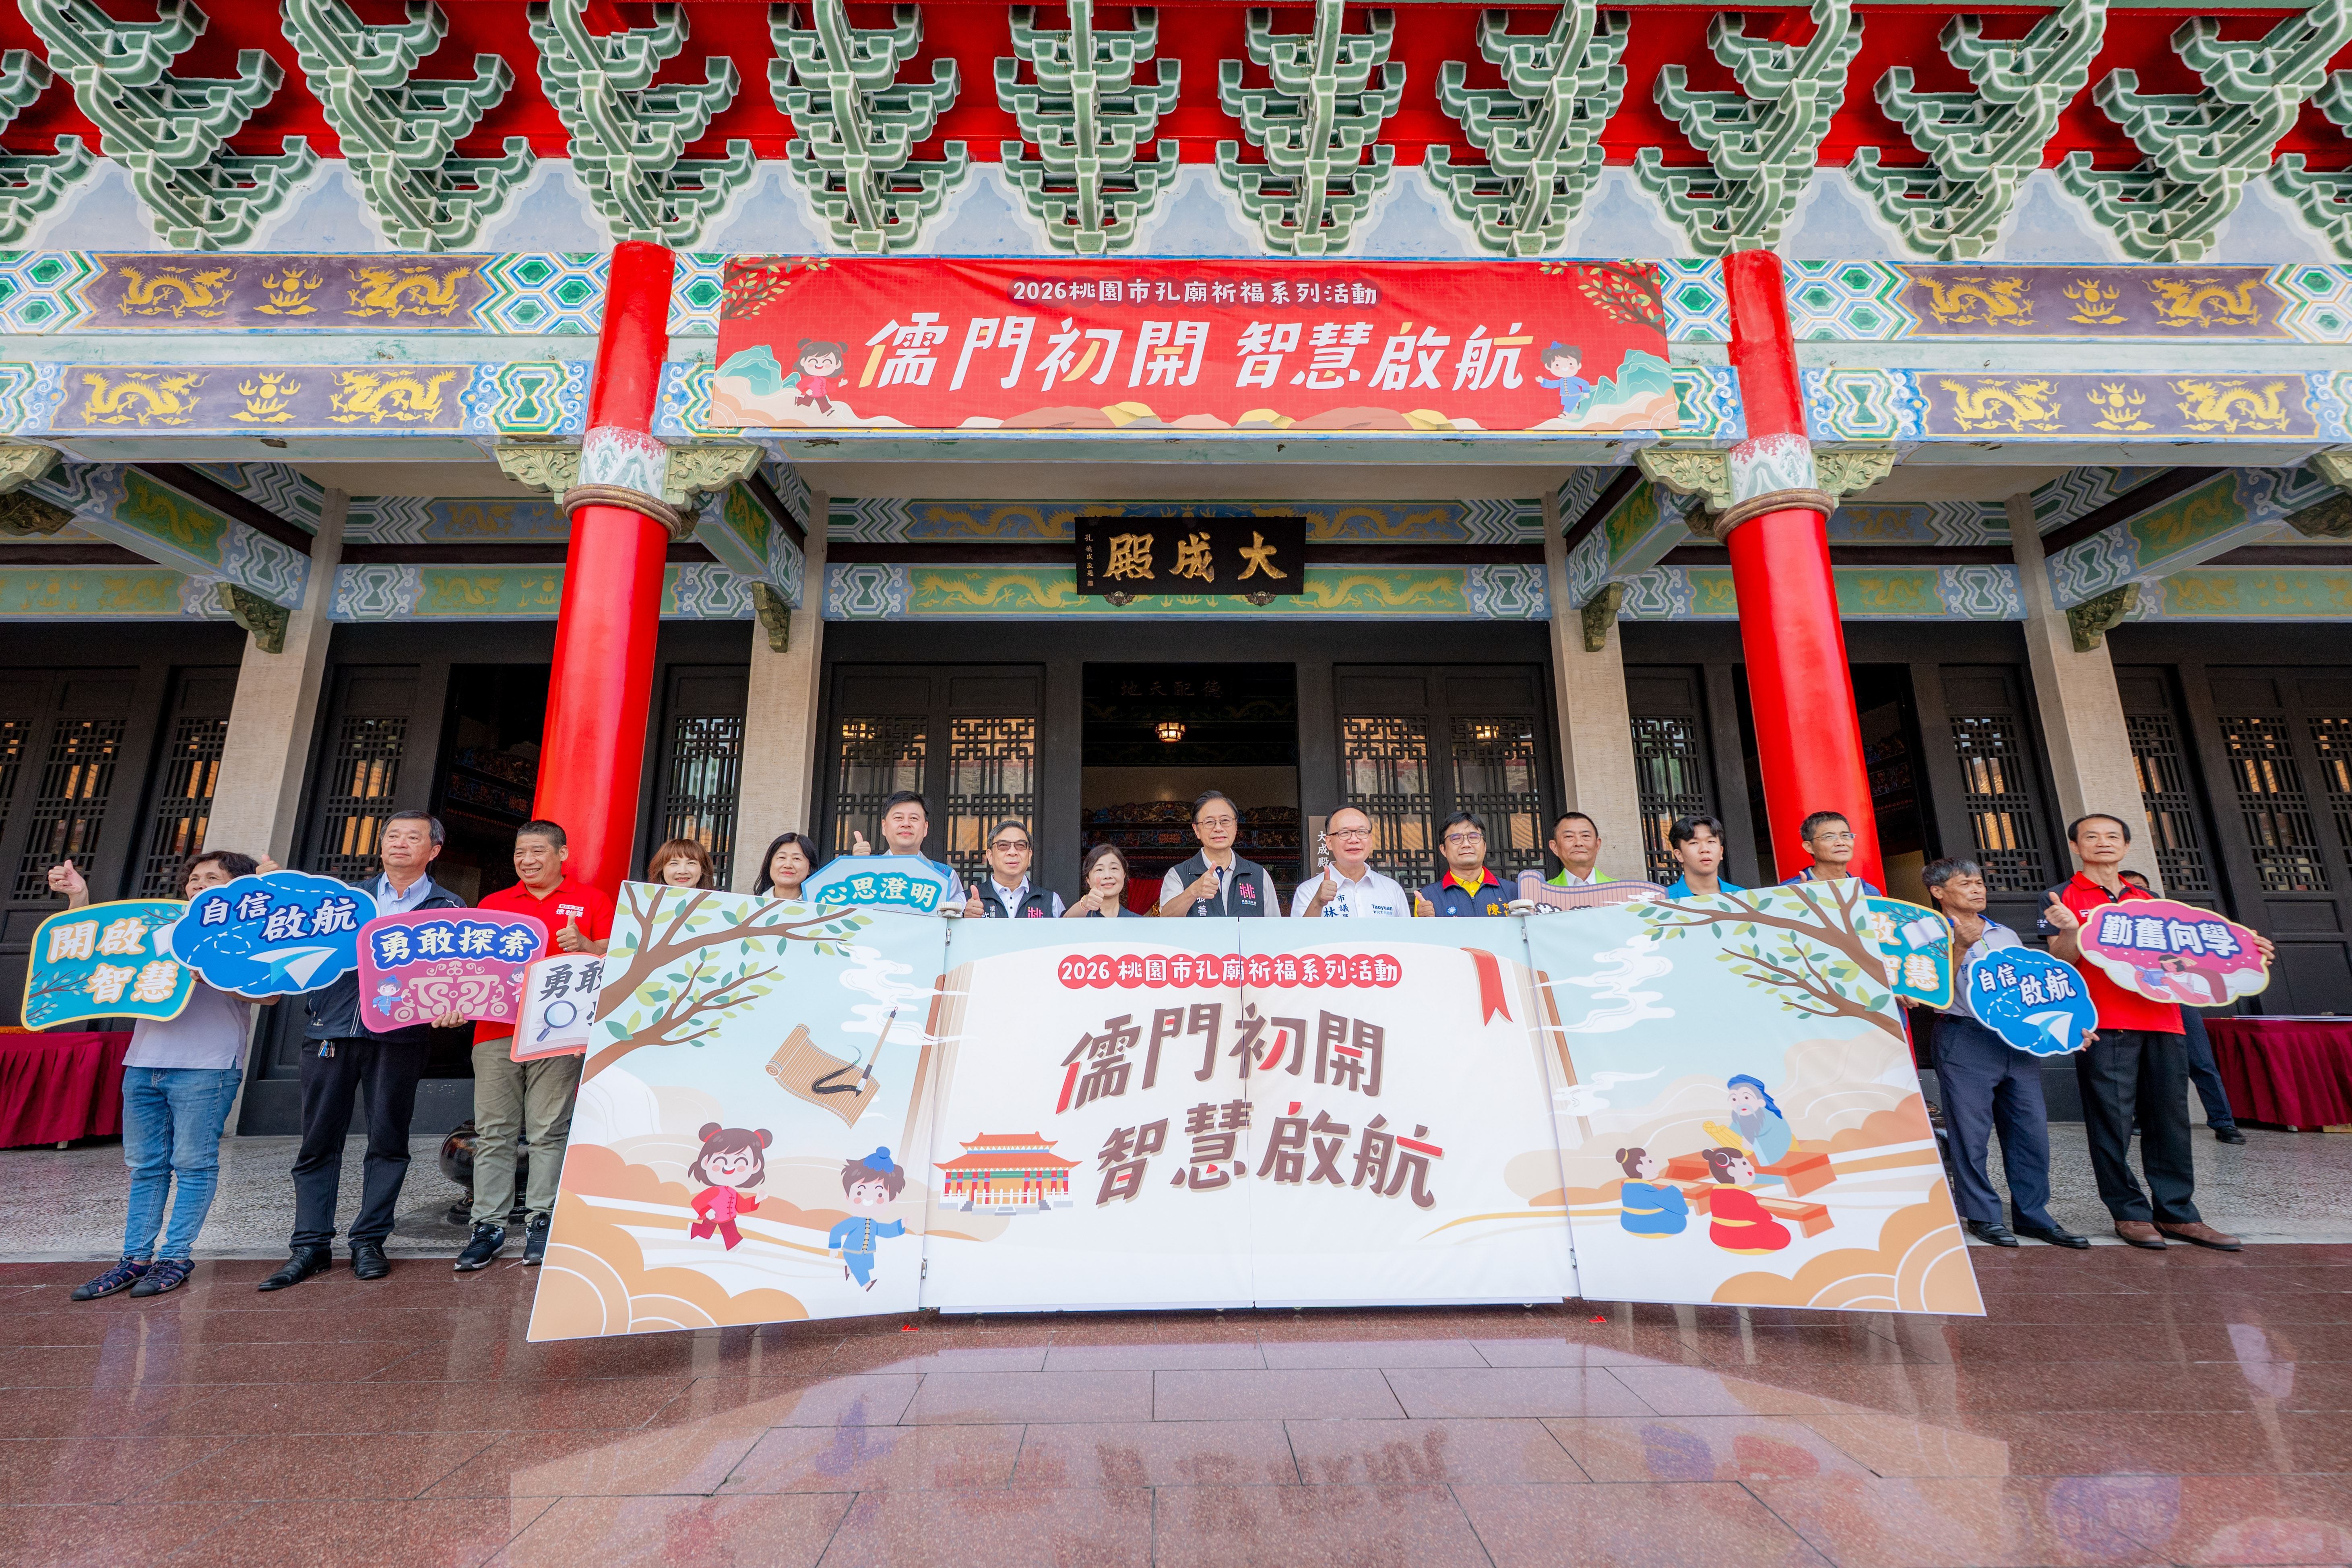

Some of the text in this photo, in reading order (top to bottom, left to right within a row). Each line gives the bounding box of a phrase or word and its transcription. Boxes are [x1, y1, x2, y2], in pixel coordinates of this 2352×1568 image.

[1013, 278, 1377, 305] 2026桃園市孔廟祈福系列活動
[858, 312, 1534, 392] 儒門初開 智慧啟航
[1102, 531, 1287, 583] 大成殿
[1120, 680, 1223, 698] 德配天地
[1317, 830, 1330, 868] 大成殿
[820, 877, 937, 907] 心思澄明
[989, 905, 996, 918] 桃園
[1487, 903, 1502, 916] 陳
[203, 892, 357, 942] 自信啟航
[2100, 915, 2240, 957] 勤奮向學
[50, 919, 147, 961] 開啟
[380, 926, 533, 963] 勇敢探索
[90, 962, 177, 1002] 智慧
[538, 959, 605, 1002] 勇敢
[1118, 957, 1398, 983] 桃園市孔廟祈福系列活動
[1978, 963, 2076, 1007] 自信啟航
[1055, 1002, 1386, 1115] 儒門初開
[1095, 1099, 1443, 1209] 智慧啟航
